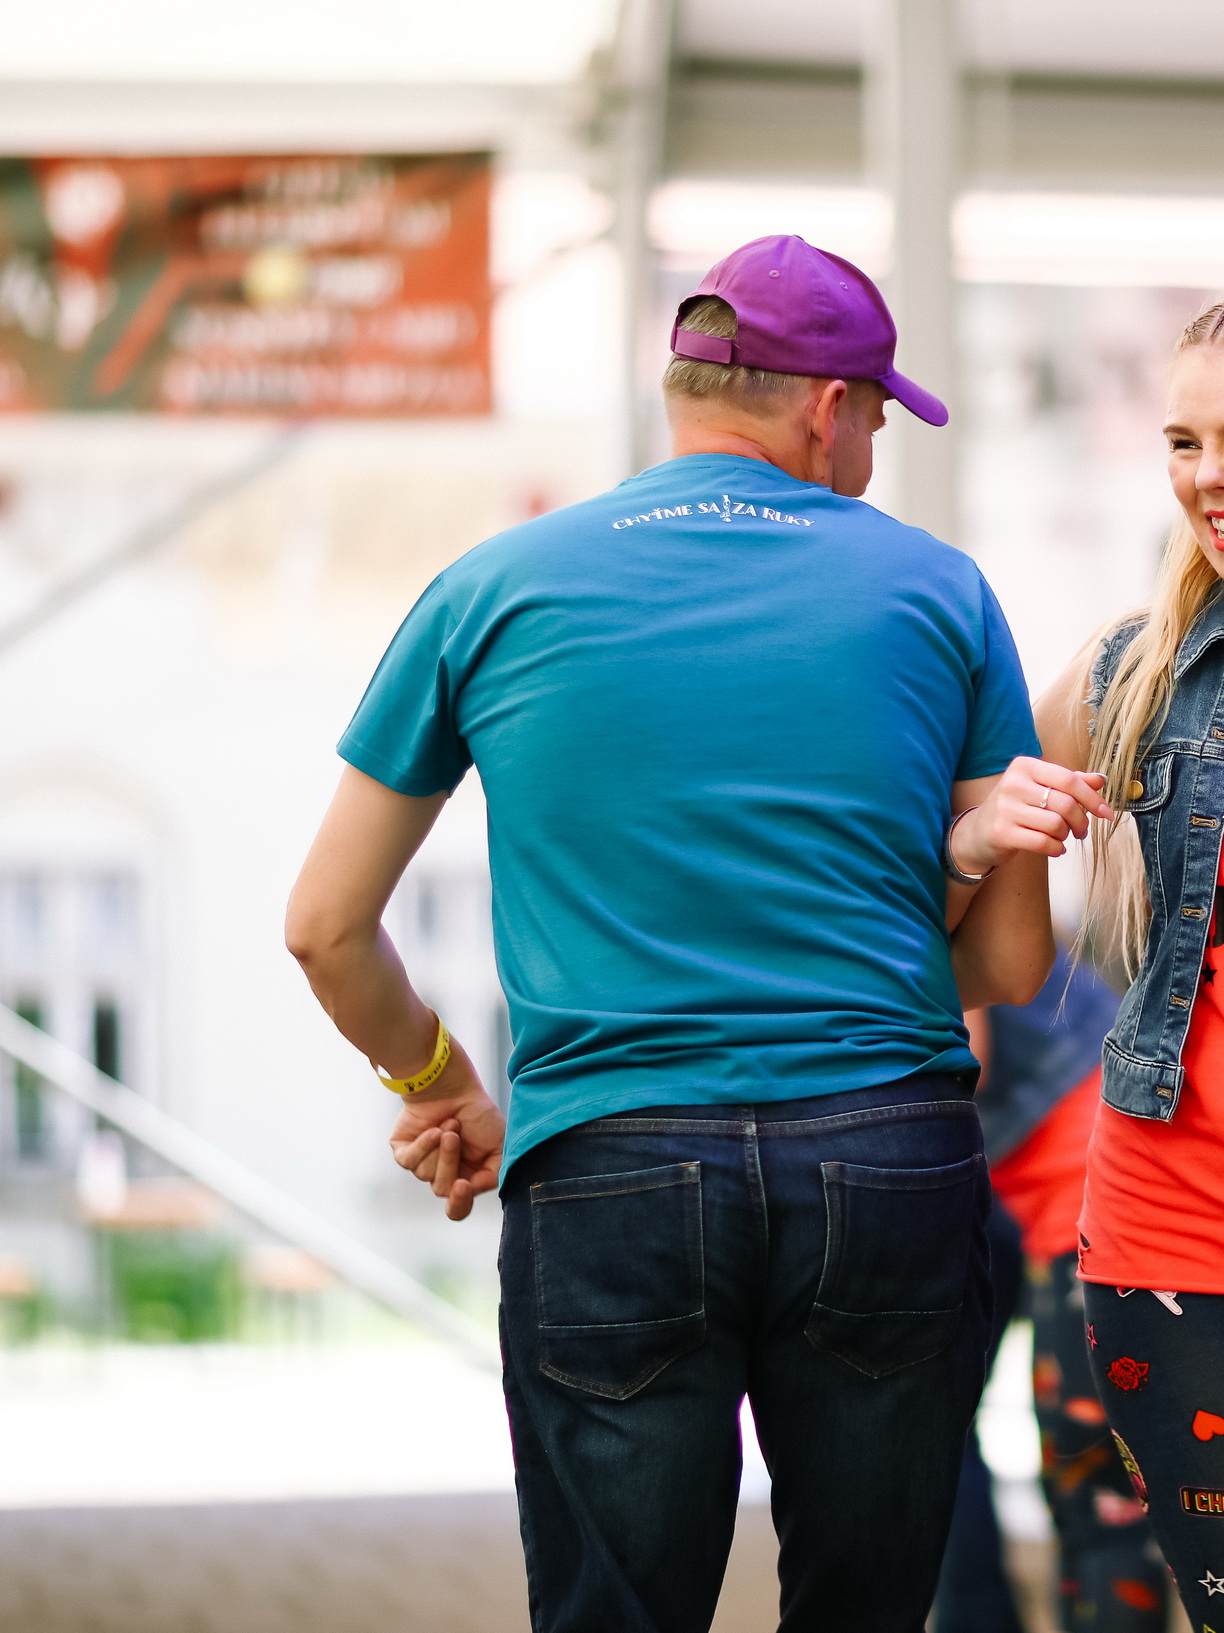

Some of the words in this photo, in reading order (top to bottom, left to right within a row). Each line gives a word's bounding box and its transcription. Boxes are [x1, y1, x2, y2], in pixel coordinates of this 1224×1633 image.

[698, 502, 721, 514] SA
[731, 502, 757, 517] ZA
[762, 507, 815, 527] RUKY
[1183, 1490, 1191, 1510] I
